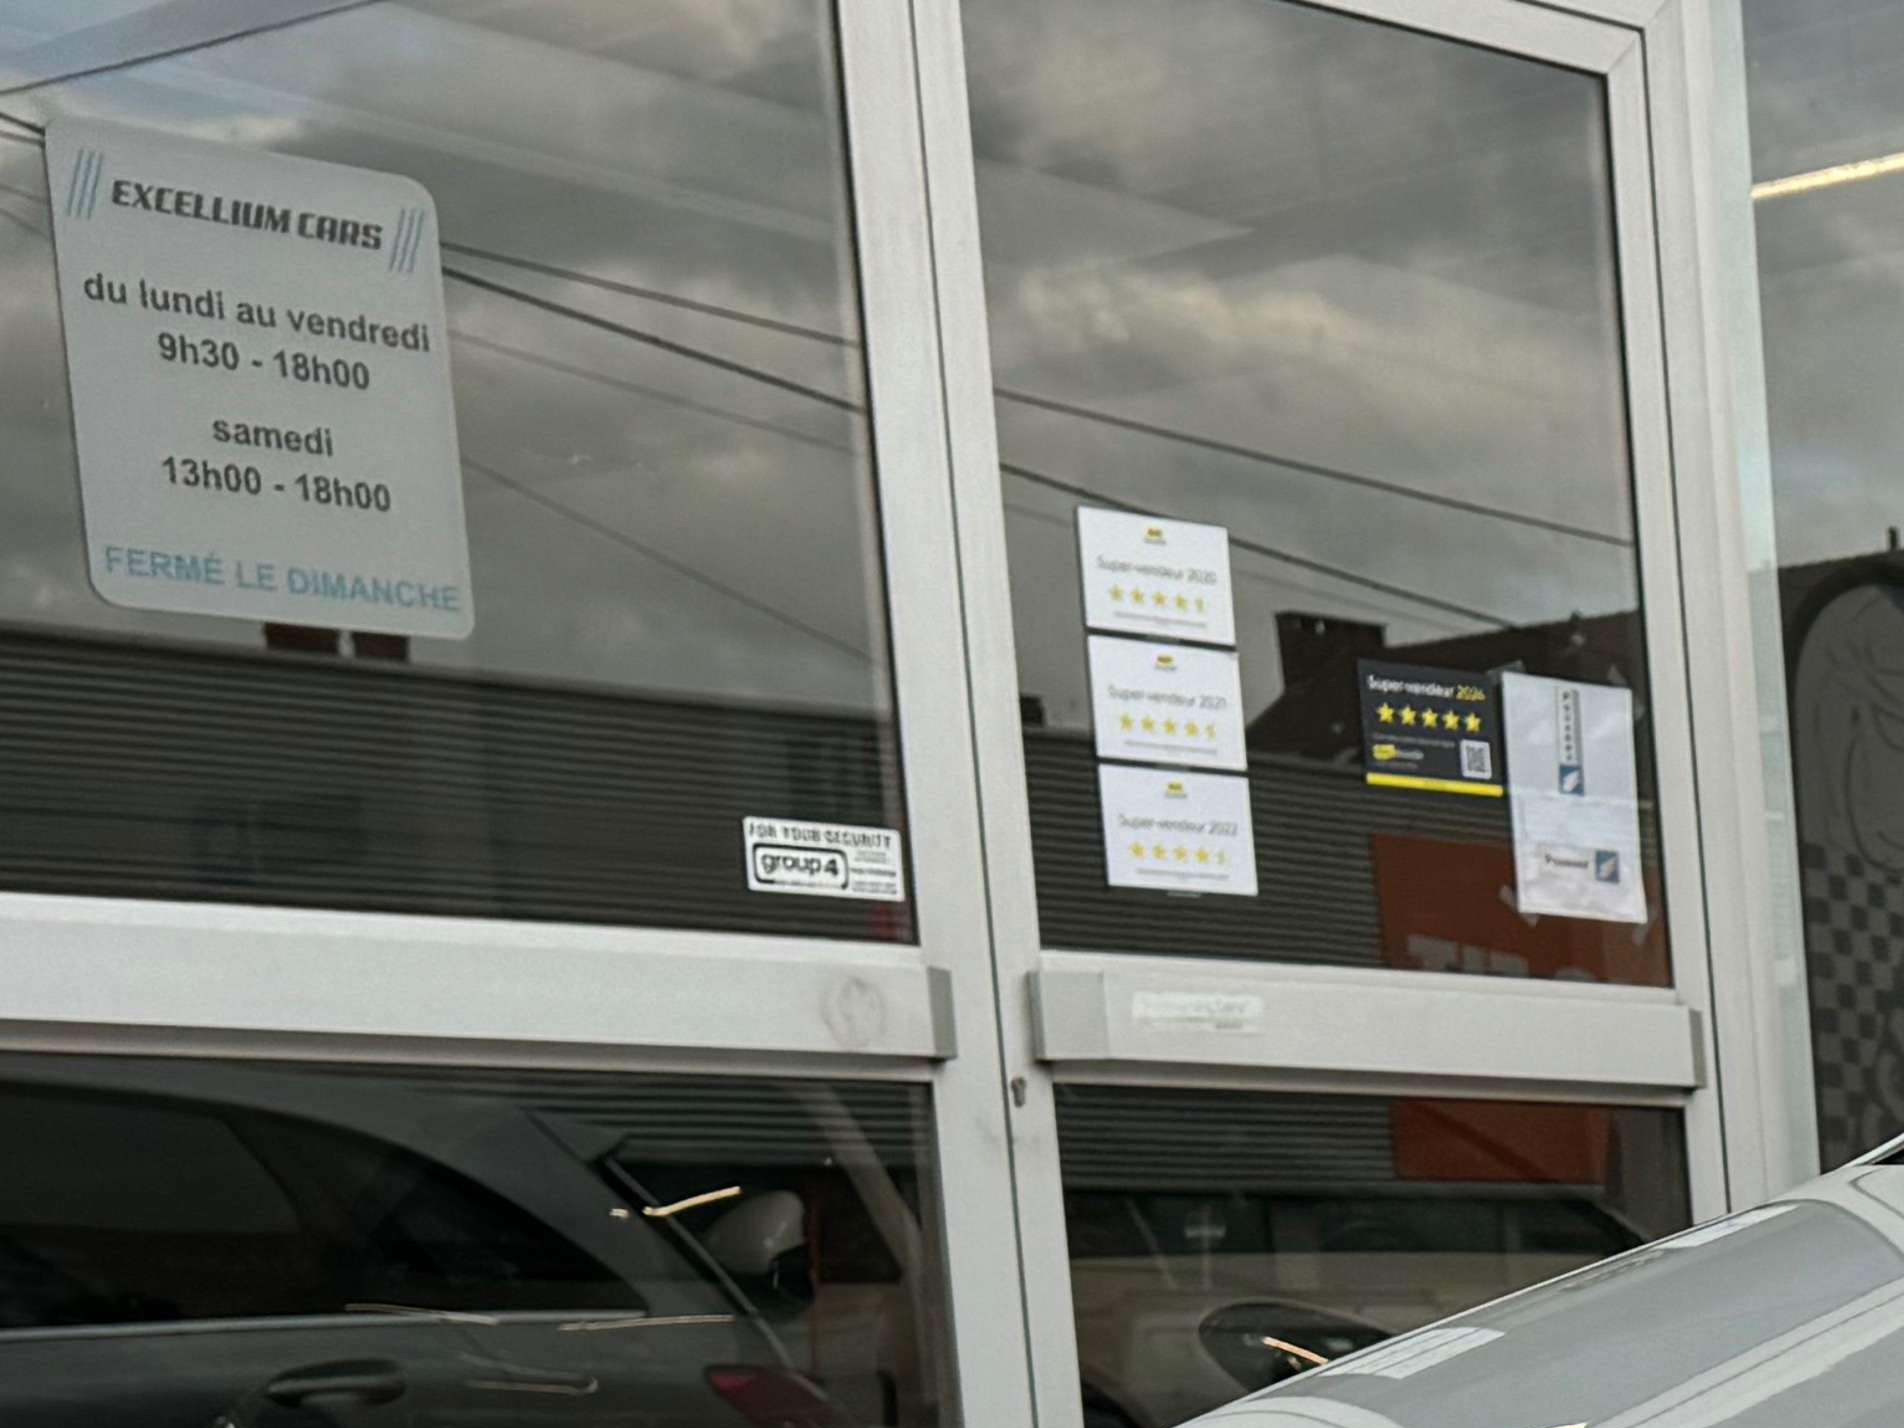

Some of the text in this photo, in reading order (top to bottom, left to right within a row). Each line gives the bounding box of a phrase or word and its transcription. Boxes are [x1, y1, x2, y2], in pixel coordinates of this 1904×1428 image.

[111, 178, 383, 251] EXCELLIUM CARS
[84, 273, 431, 353] du lundi au vendredi
[157, 332, 240, 371] 9h30
[273, 350, 371, 391] 18h00
[212, 416, 333, 458] samedi
[161, 456, 262, 496] 13h00
[295, 474, 391, 513] 18h00
[103, 545, 461, 612] FERMÉ LE DIMANCHE
[783, 826, 821, 842] YOUR
[824, 830, 892, 848] SECURITY
